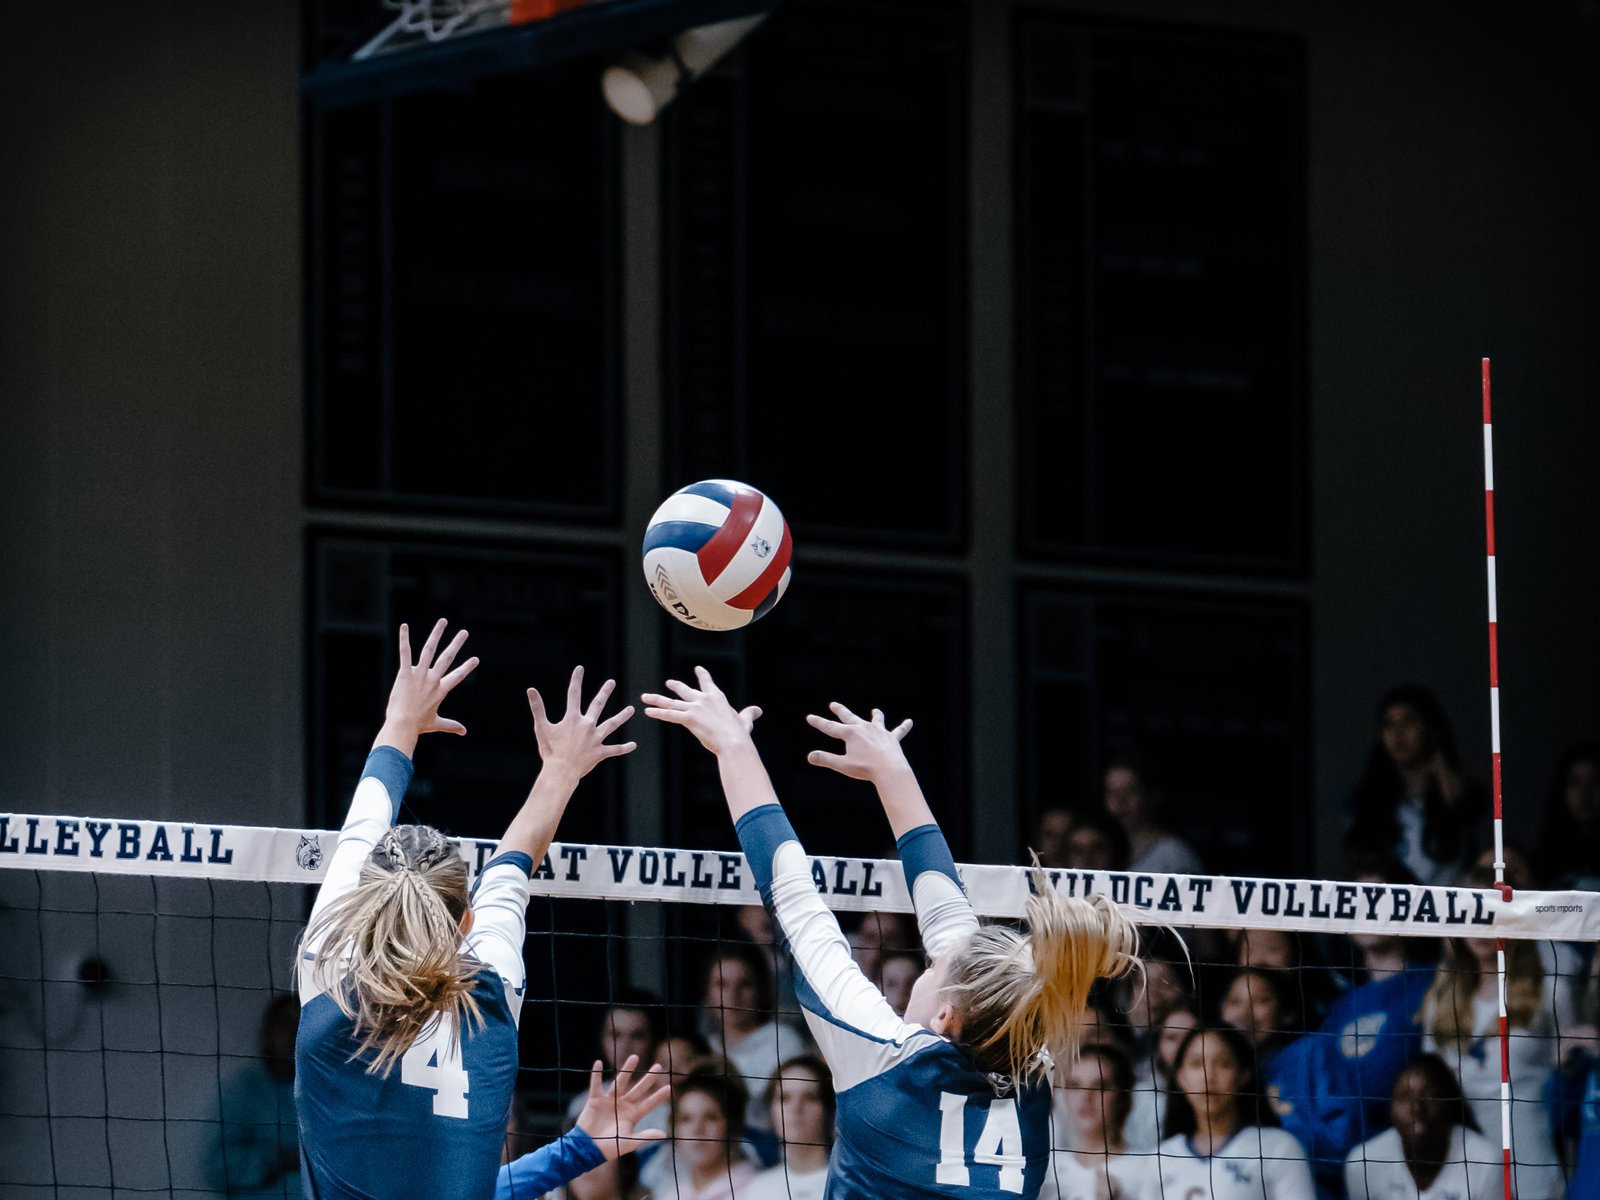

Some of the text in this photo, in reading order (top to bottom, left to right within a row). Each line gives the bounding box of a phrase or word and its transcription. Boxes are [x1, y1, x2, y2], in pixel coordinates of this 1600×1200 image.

[607, 848, 882, 897] VOLLEALL
[1230, 880, 1495, 925] VOLLEYBALL
[1535, 905, 1556, 914] sports
[401, 1009, 469, 1120] 4
[936, 1091, 1026, 1194] 14
